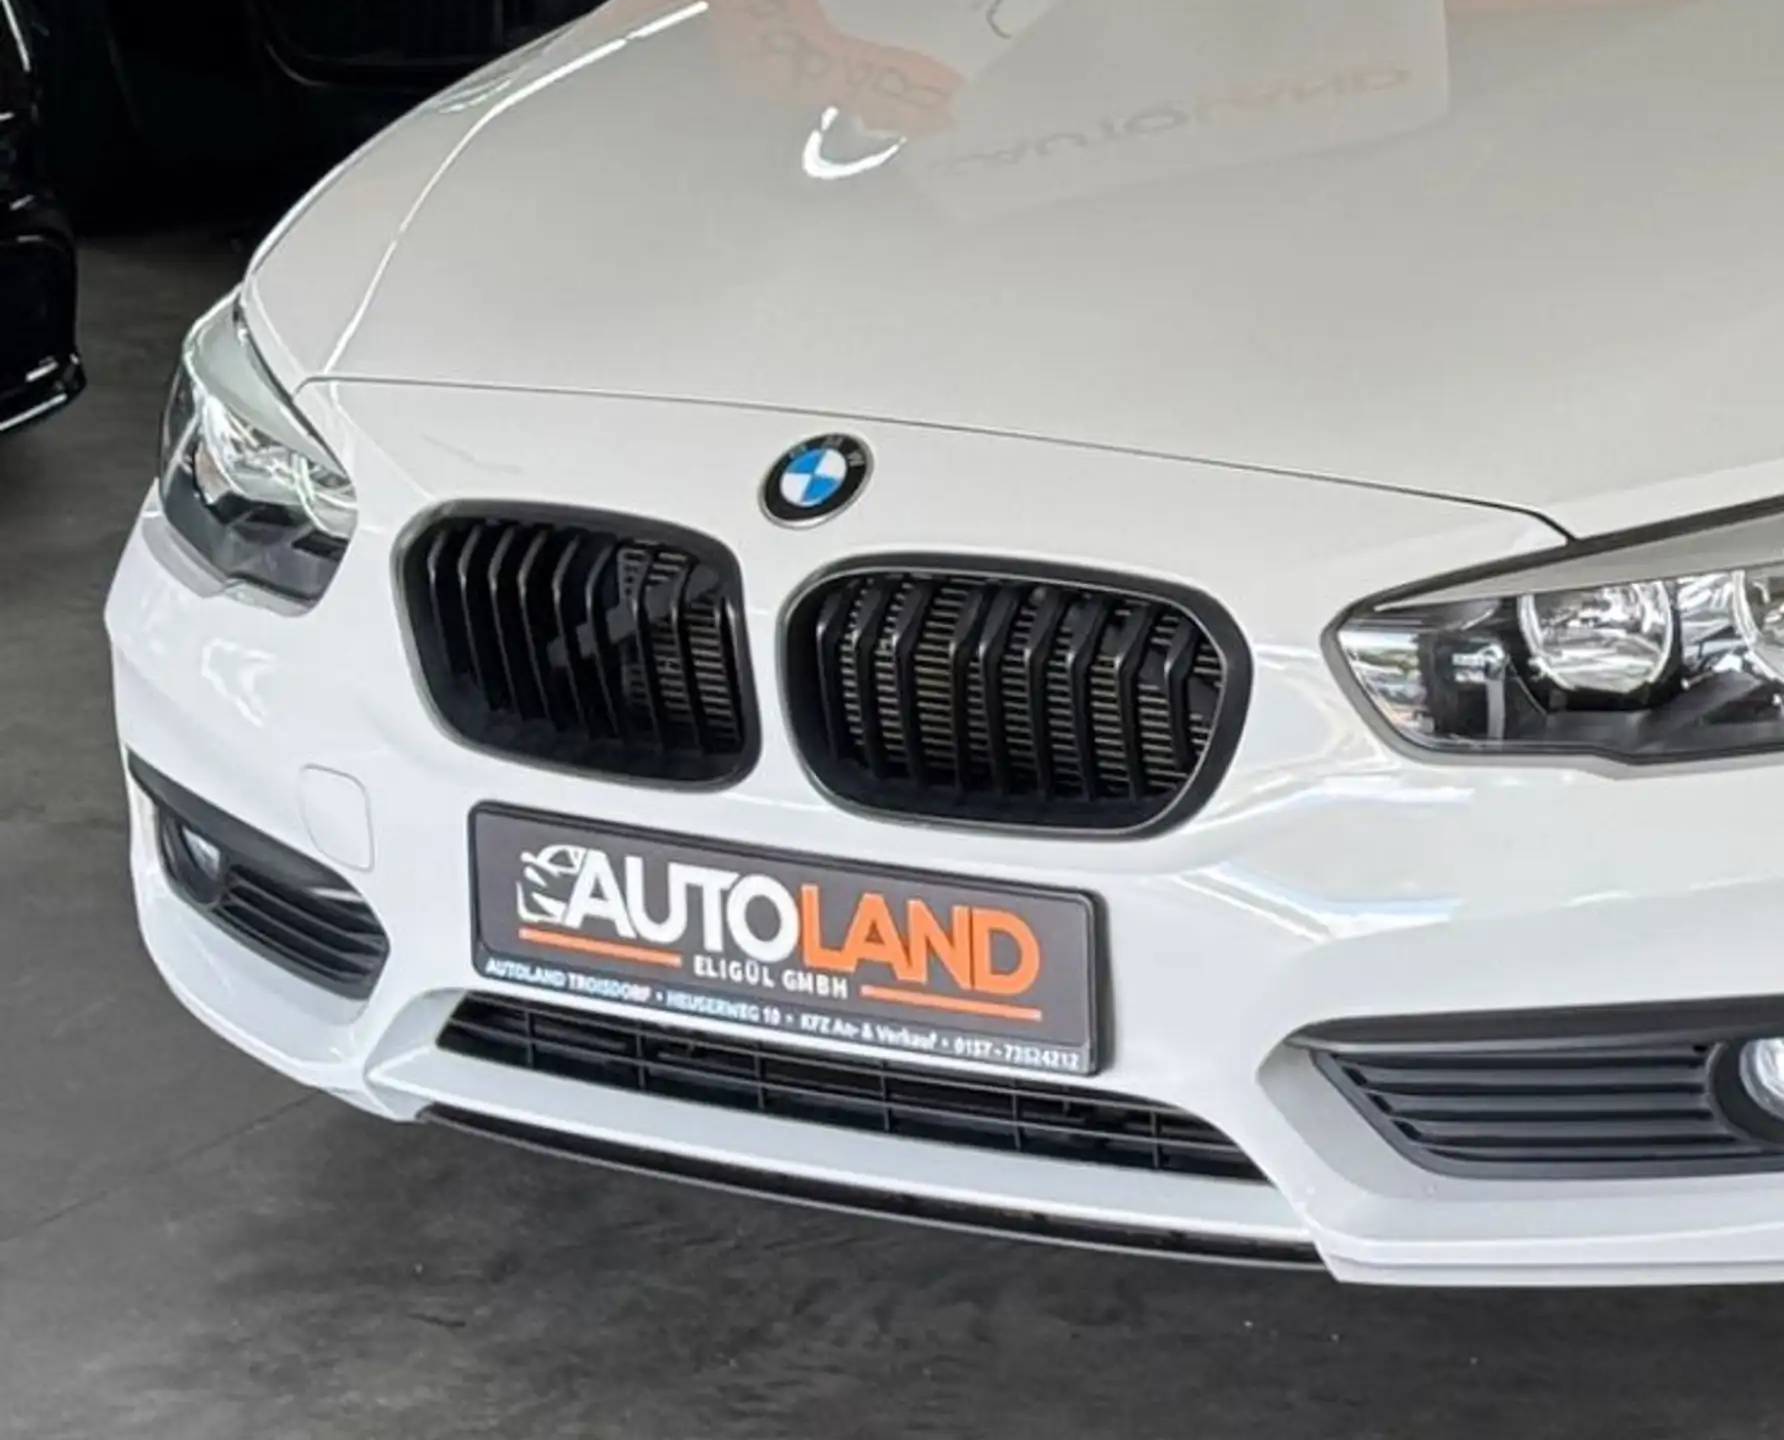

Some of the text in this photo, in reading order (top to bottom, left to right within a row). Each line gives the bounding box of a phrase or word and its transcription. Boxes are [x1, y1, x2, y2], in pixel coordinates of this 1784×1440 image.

[561, 847, 1041, 997] AUTOLAND
[486, 958, 566, 988] AUTOLAND
[568, 971, 651, 1003] TROISDORF
[876, 1025, 938, 1051] Verkauf
[693, 954, 848, 1000] ELIGÜL GMBH
